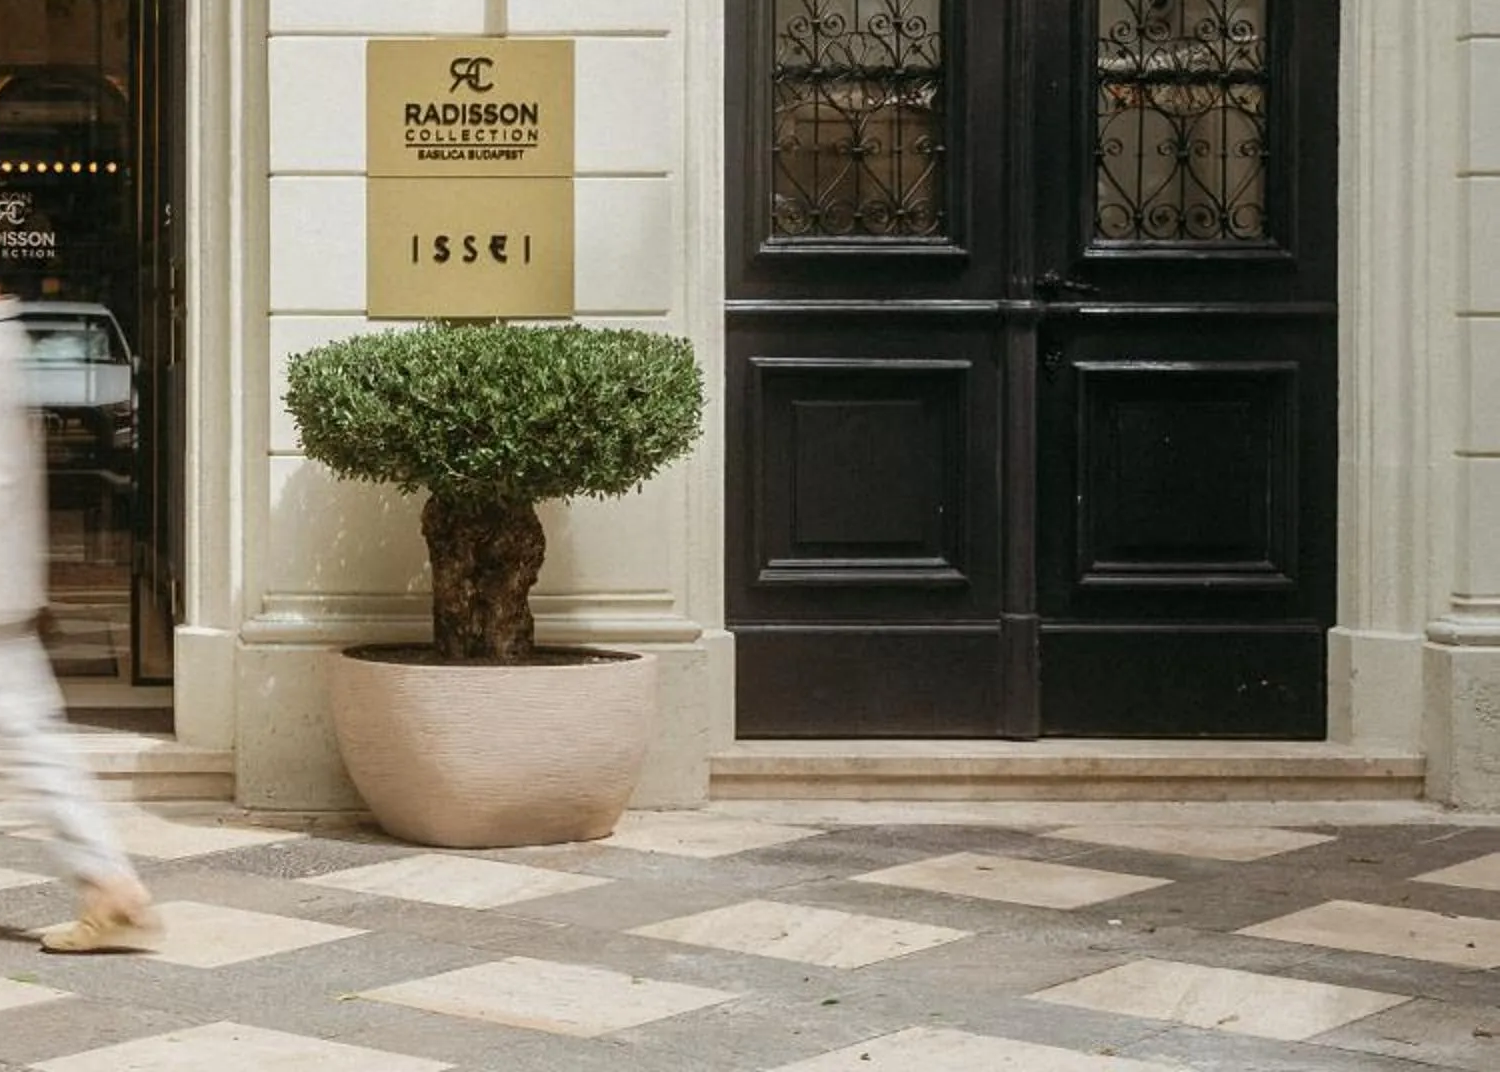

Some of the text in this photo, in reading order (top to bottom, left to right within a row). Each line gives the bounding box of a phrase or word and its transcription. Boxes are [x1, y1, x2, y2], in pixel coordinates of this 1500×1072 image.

[404, 103, 539, 126] RADISSON
[405, 129, 539, 141] COLLECTION
[417, 149, 525, 160] BASILICA BUDAPEST
[411, 234, 531, 263] ISSEI
